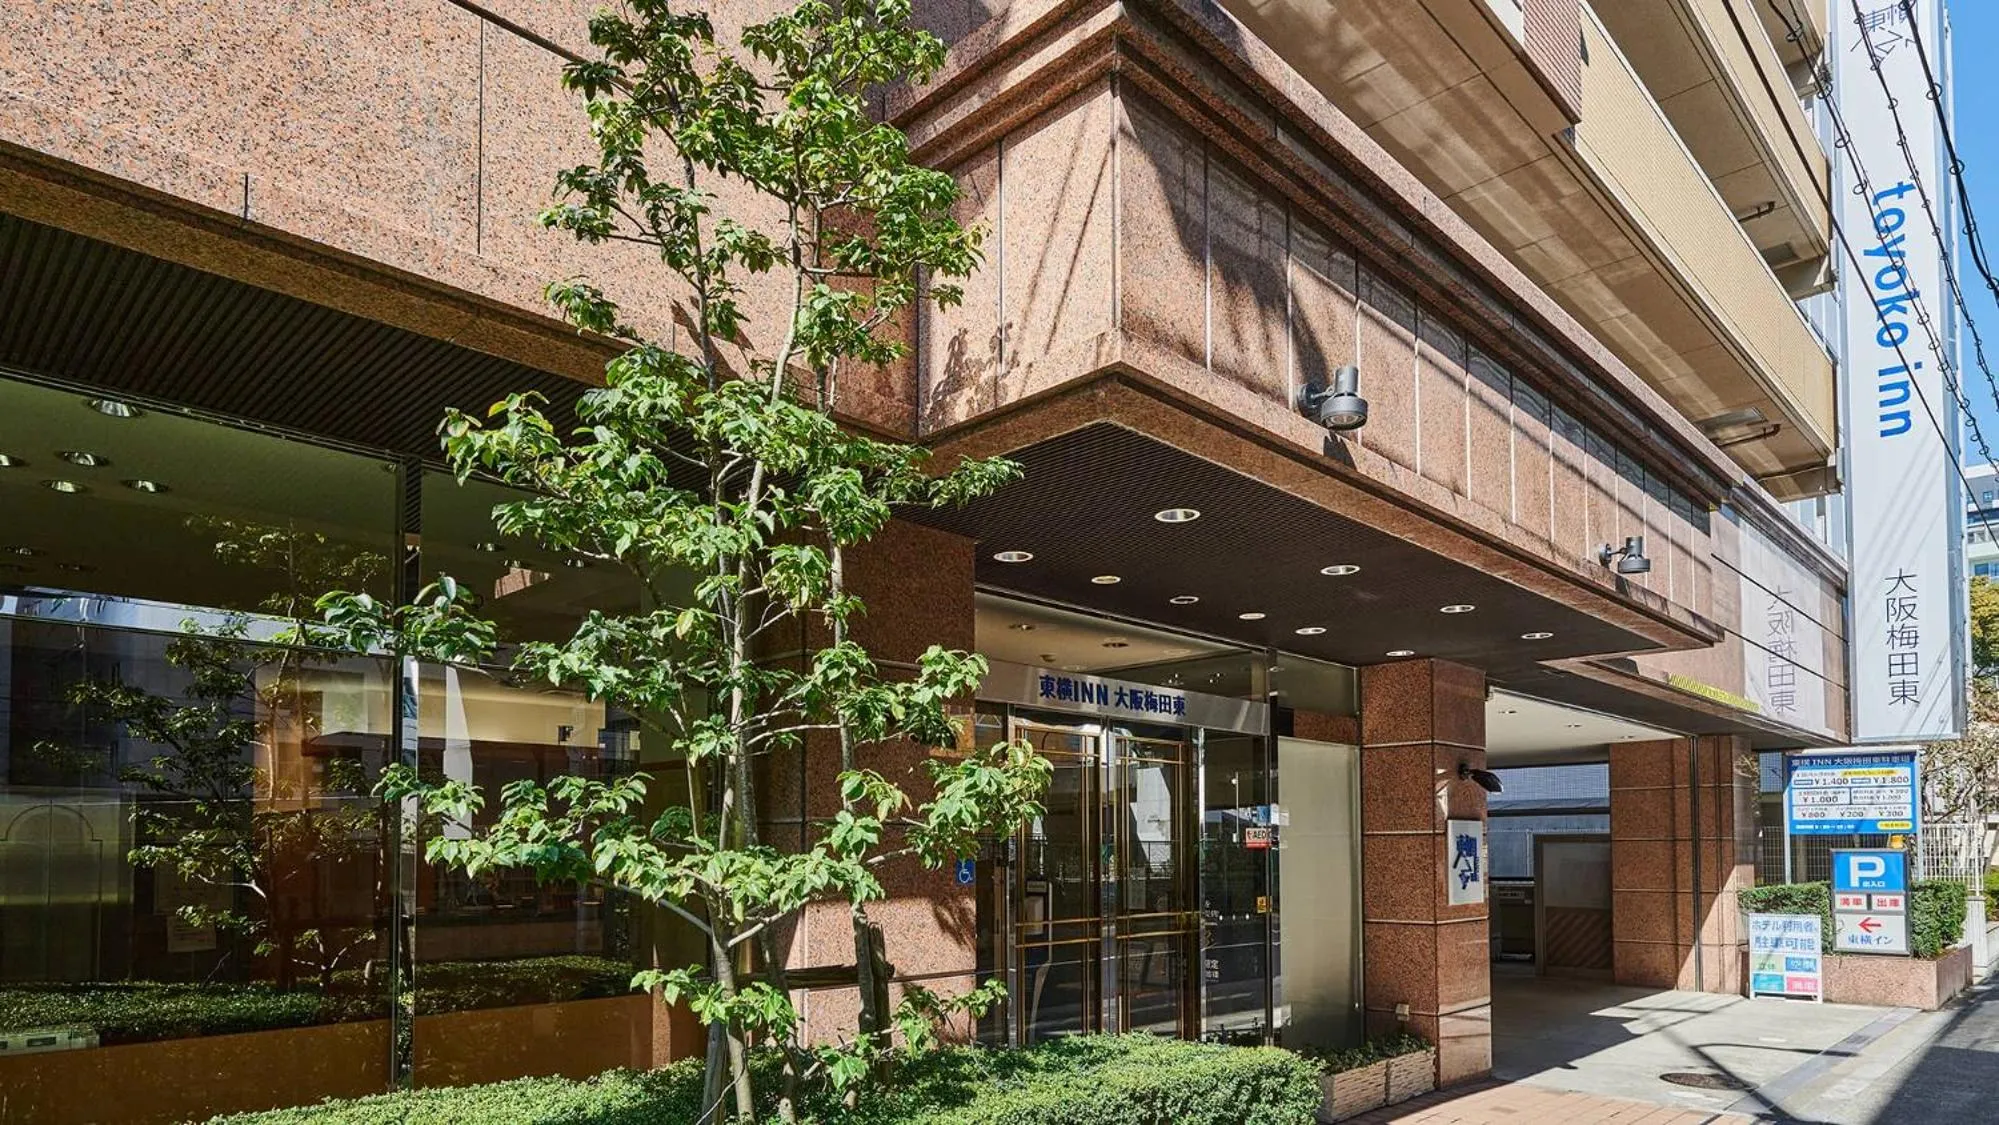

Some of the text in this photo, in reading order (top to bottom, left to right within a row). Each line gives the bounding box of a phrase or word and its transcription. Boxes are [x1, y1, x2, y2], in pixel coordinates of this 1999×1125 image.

[1864, 181, 1923, 438] toyoko inn
[1884, 568, 1921, 706] 大阪梅田東
[1039, 674, 1187, 717] 東横INN 大阪梅田東
[1849, 855, 1886, 888] P
